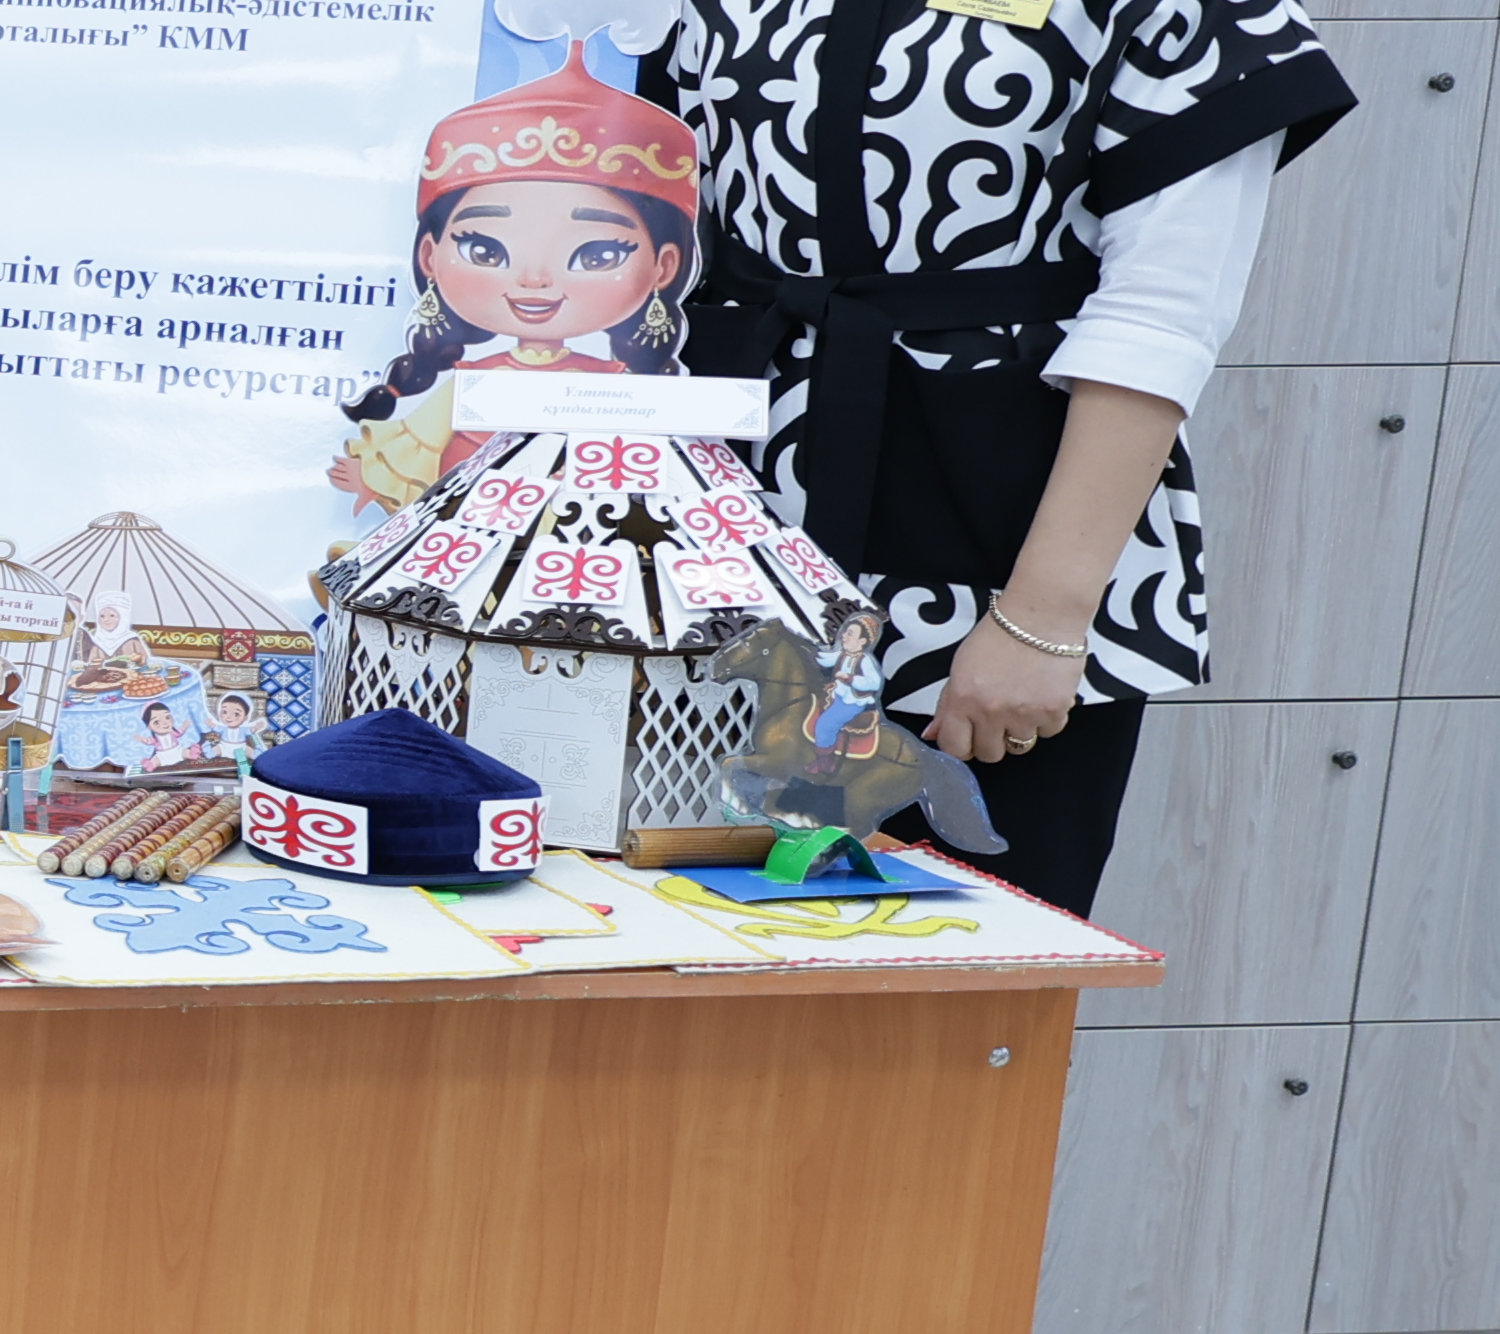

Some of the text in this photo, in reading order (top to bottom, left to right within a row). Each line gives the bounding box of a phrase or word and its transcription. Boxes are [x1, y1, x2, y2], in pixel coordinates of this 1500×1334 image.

[157, 24, 250, 53] КММ
[73, 257, 159, 299] беру
[170, 271, 398, 309] қажеттілігі
[155, 312, 345, 352] арналған
[156, 357, 382, 404] ресурстар”
[563, 386, 635, 400] Ұлттық
[542, 404, 657, 419] құндылықтар
[14, 613, 59, 628] торғай
